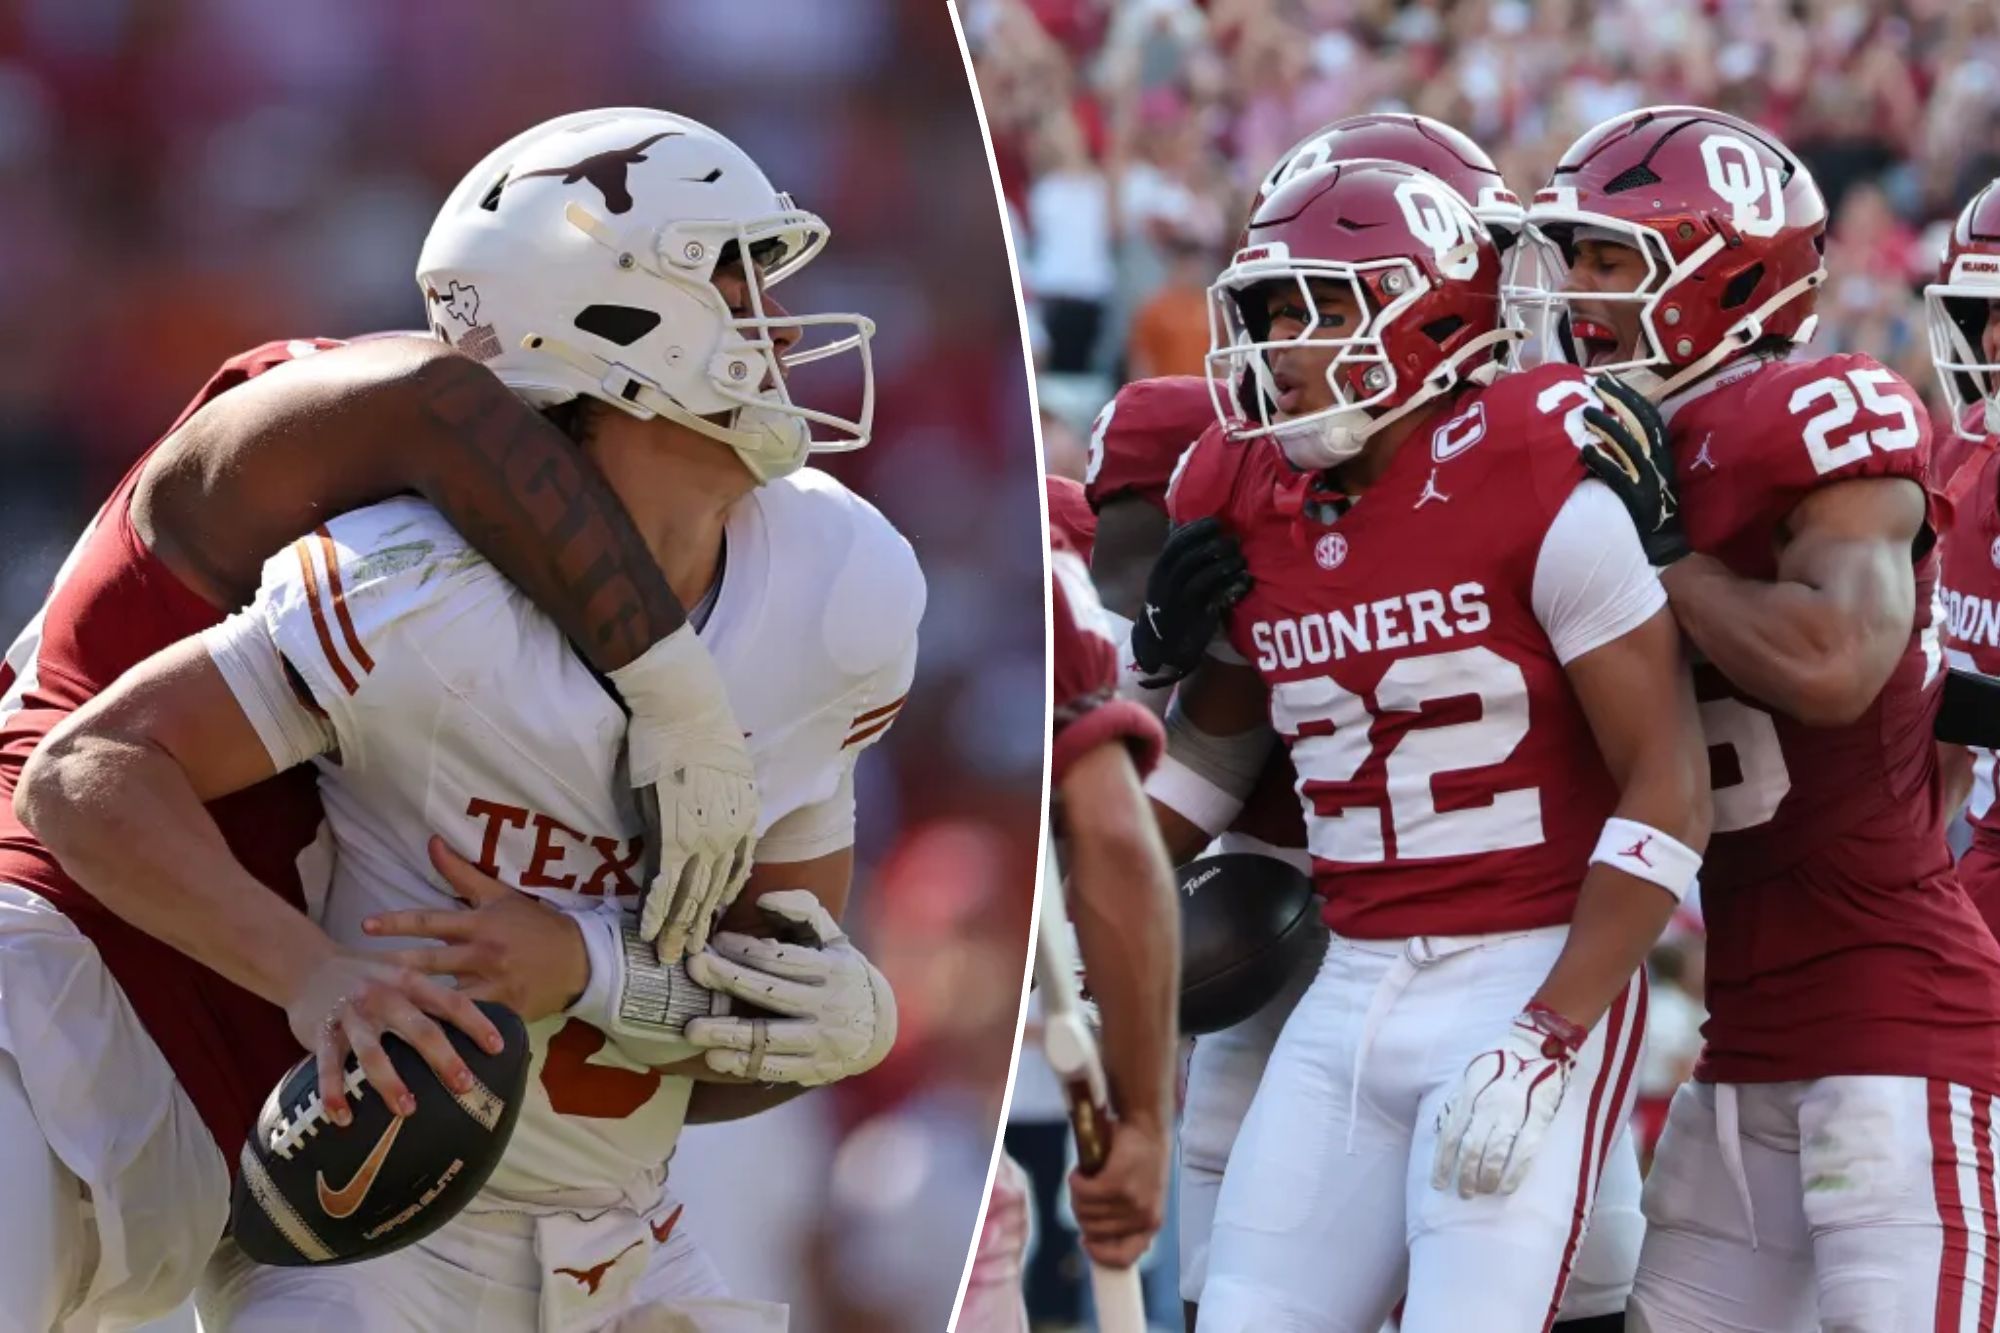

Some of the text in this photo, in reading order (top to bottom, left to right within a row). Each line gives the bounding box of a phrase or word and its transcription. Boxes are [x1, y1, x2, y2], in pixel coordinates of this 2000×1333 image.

[1394, 182, 1479, 281] OU
[1700, 134, 1785, 238] OU
[1431, 401, 1486, 463] C
[1788, 369, 1920, 476] 25
[1315, 533, 1348, 569] SEC
[1251, 581, 1492, 672] SOONERS
[1270, 646, 1546, 864] 22
